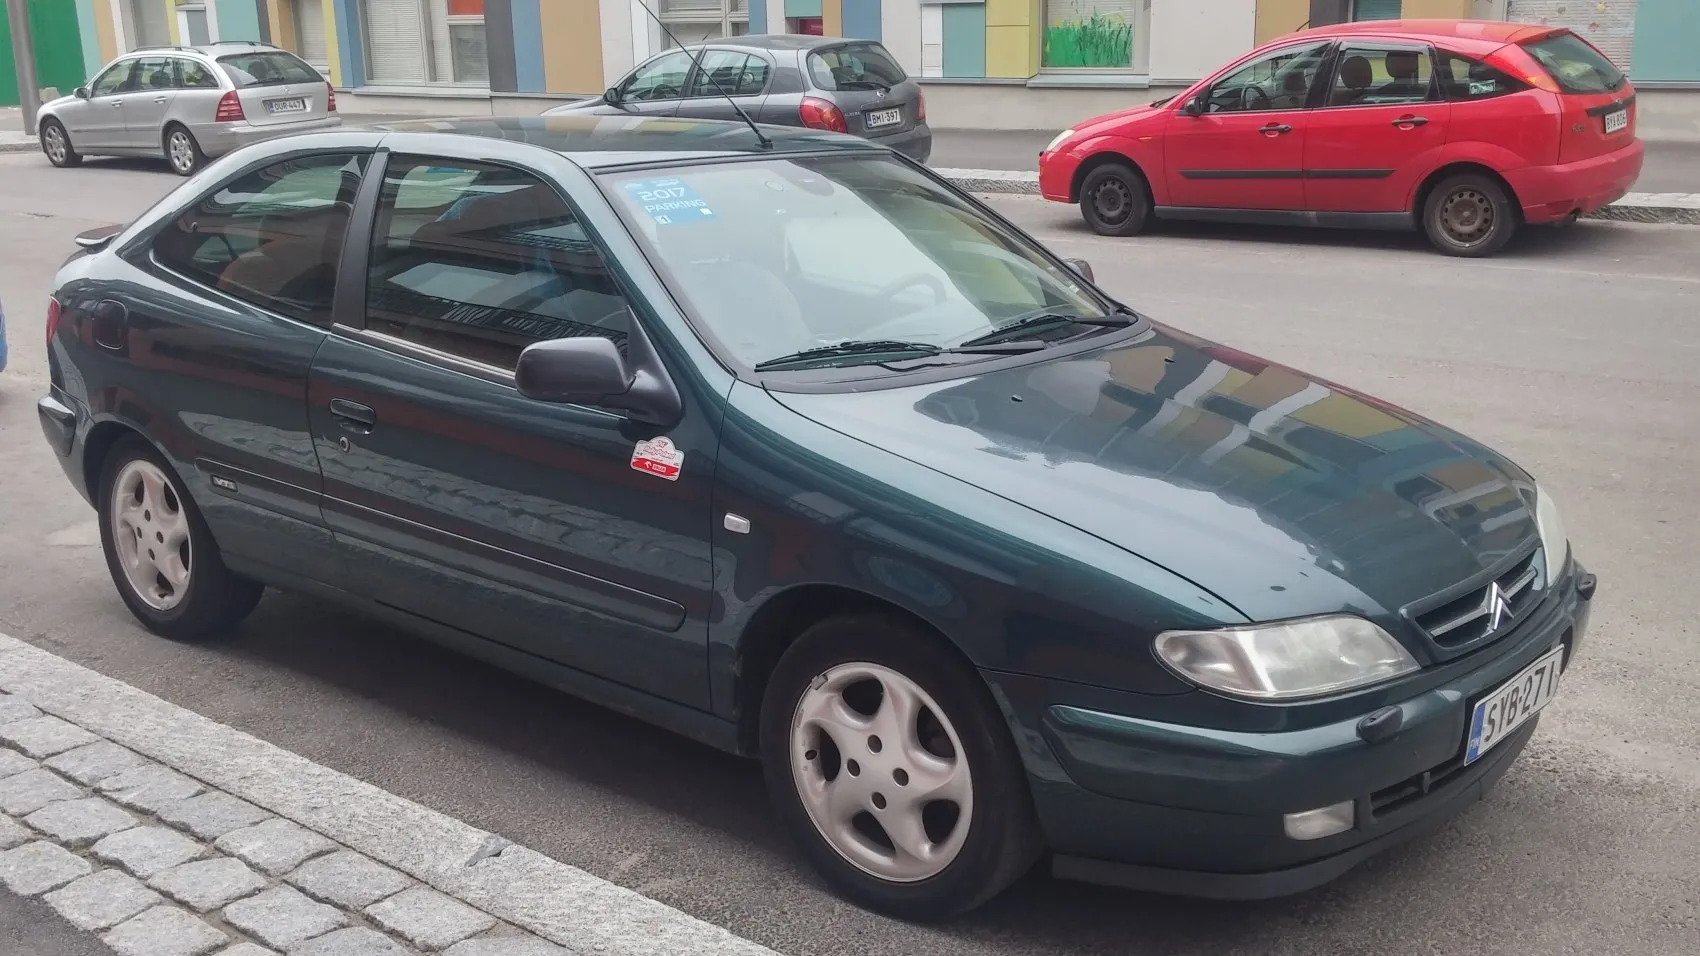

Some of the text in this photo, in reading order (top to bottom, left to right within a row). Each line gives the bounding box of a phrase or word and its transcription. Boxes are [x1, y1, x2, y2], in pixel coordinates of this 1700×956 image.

[871, 110, 898, 125] BMI-397
[637, 187, 685, 201] 2017
[644, 199, 707, 213] PARKING
[1483, 660, 1556, 742] SYB-271
